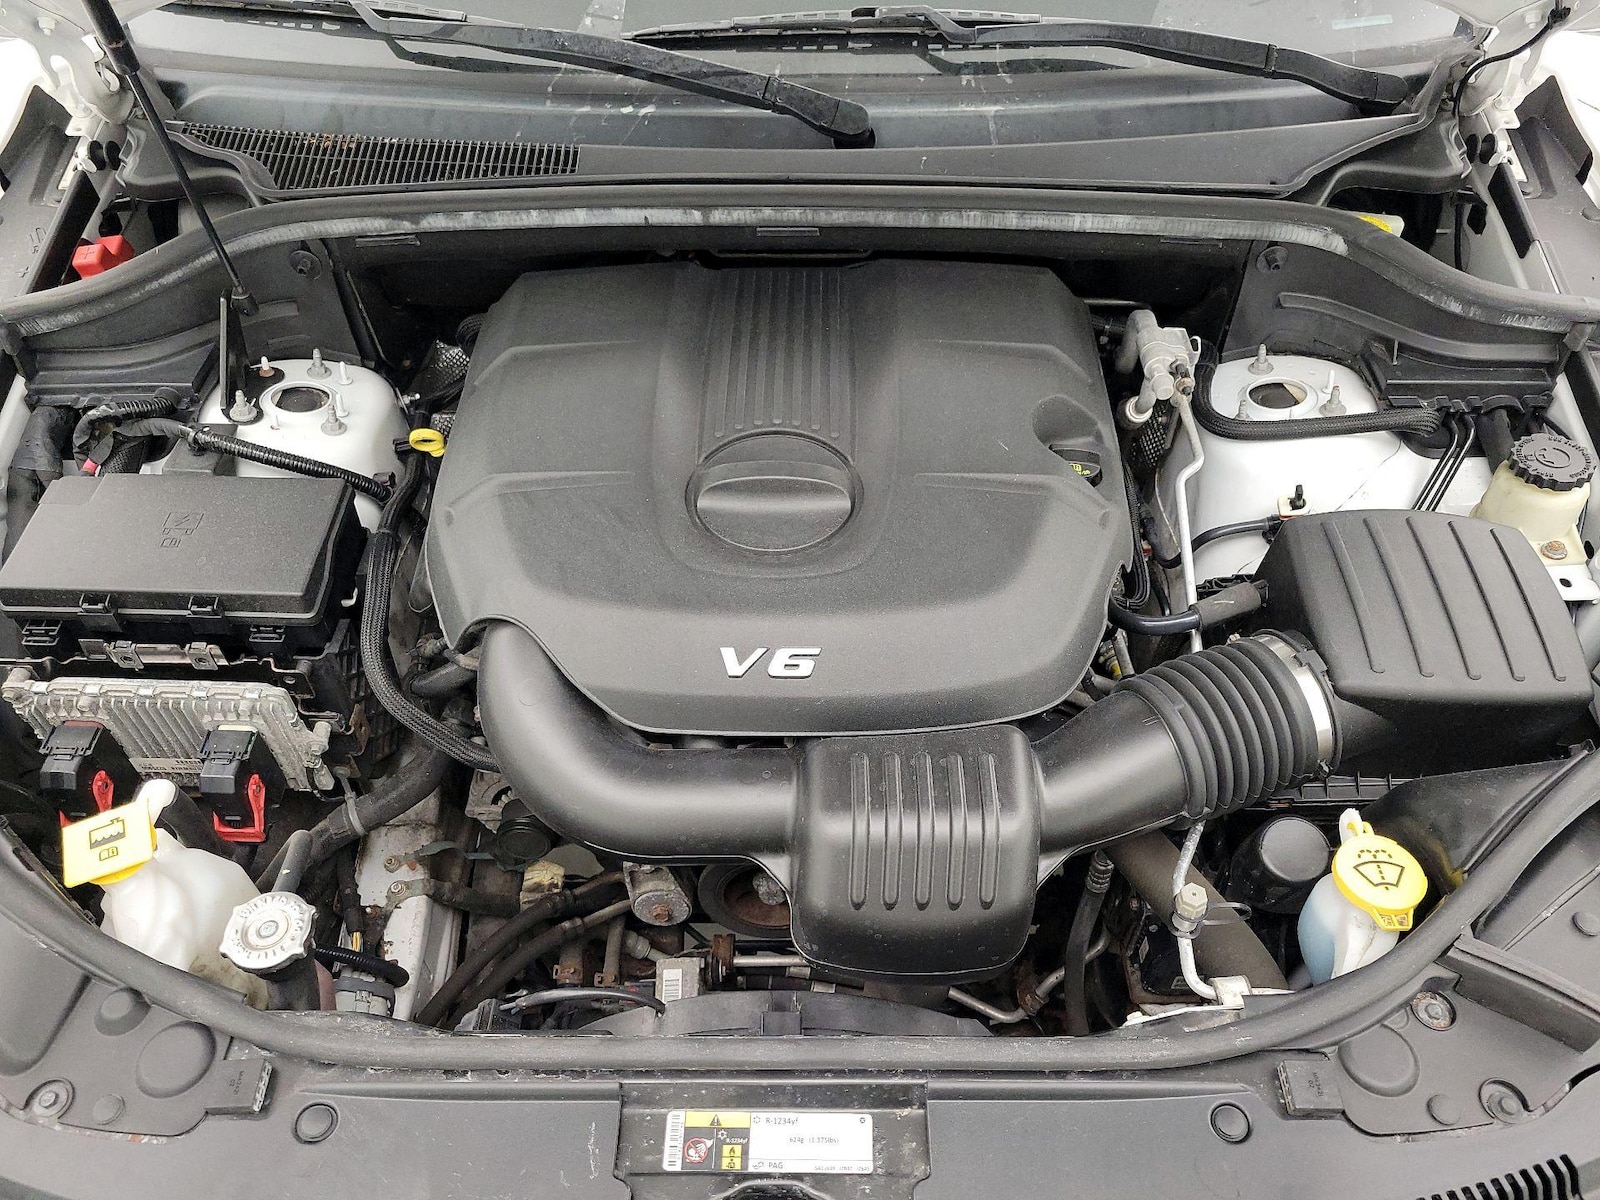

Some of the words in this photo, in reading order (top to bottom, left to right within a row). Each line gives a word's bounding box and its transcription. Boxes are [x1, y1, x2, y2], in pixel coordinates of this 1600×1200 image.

[720, 646, 822, 679] V6
[765, 1117, 799, 1126] R-1234yf
[789, 1136, 805, 1145] 624g
[768, 1161, 784, 1170] PAG
